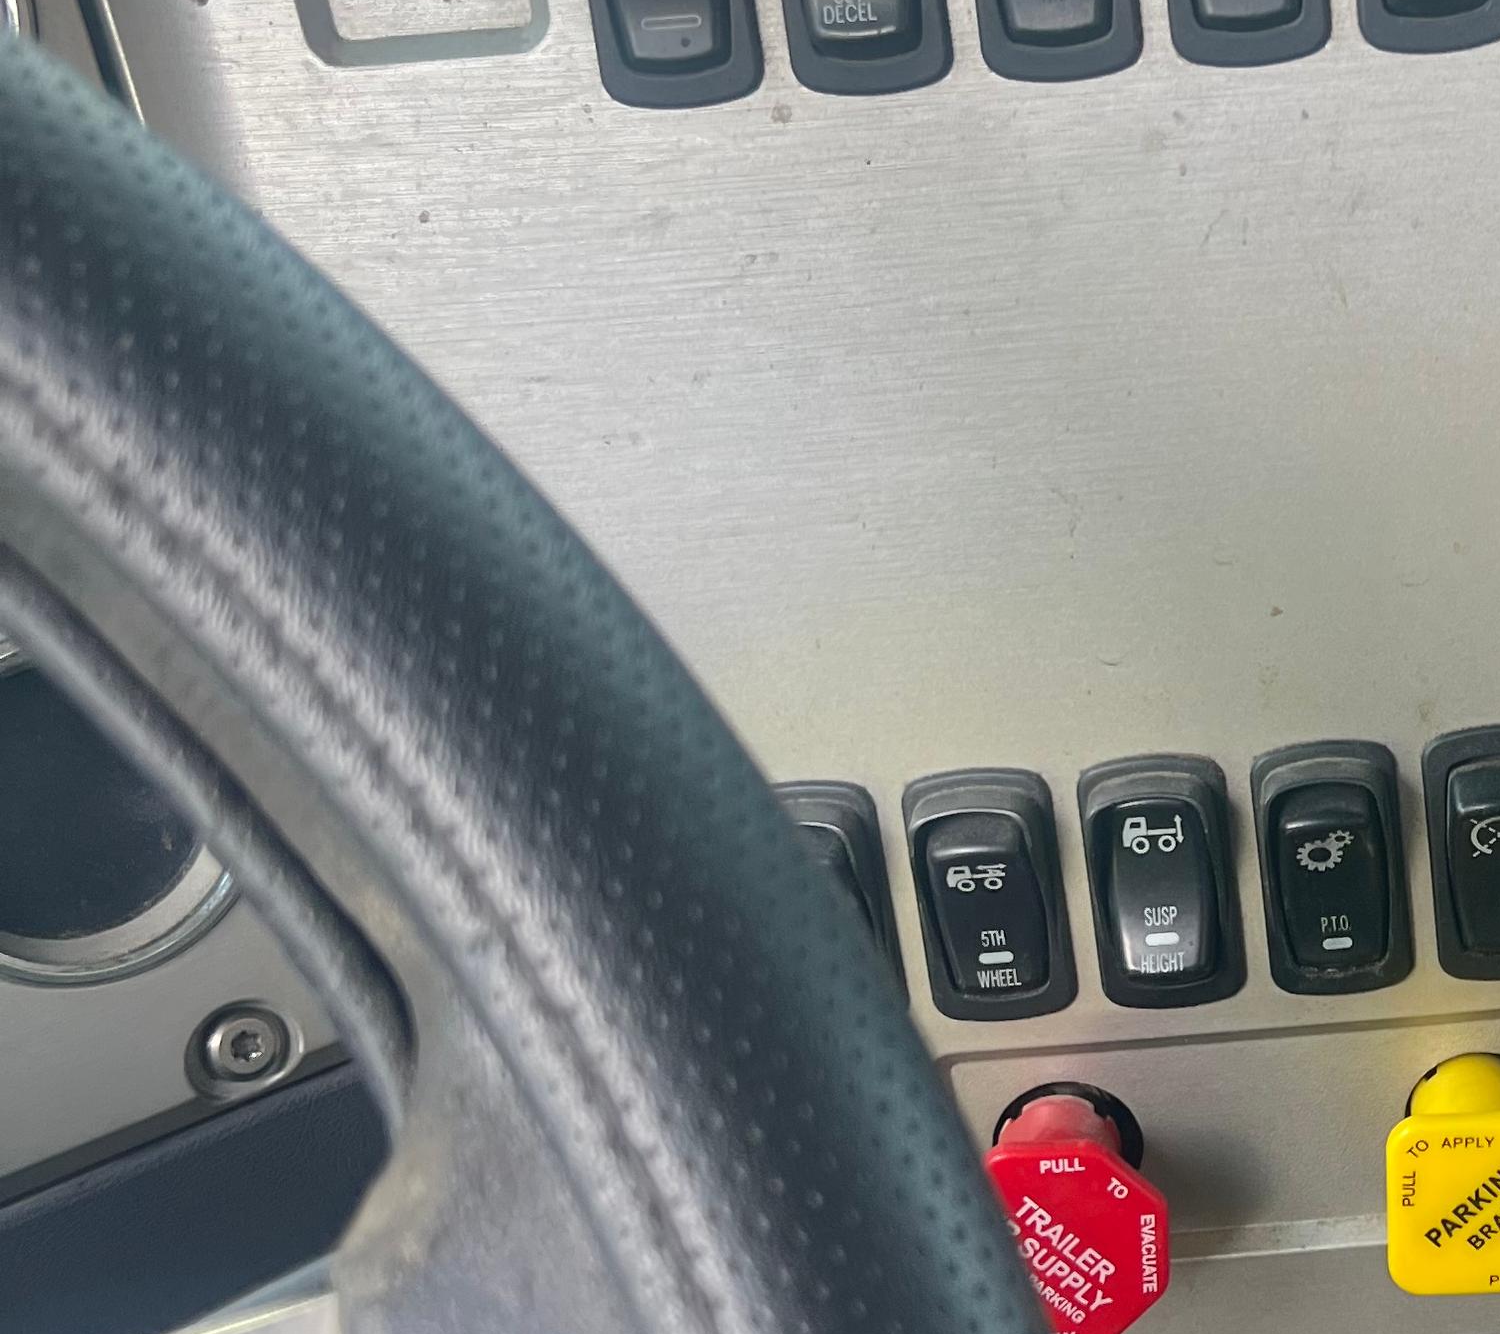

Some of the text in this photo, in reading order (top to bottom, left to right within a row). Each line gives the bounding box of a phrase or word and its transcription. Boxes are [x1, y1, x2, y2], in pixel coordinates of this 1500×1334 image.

[823, 1, 878, 25] DECEL
[1143, 905, 1178, 927] SUSP
[980, 929, 1007, 948] 5TH
[1140, 951, 1185, 974] HEIGHT
[976, 968, 1022, 989] WHEEL
[1402, 1136, 1495, 1208] PULL TO APPLY
[1039, 1157, 1158, 1295] PULL TO EVACUATE
[1015, 1195, 1116, 1285] TRAILER
[1018, 1237, 1114, 1313] SUPPLY
